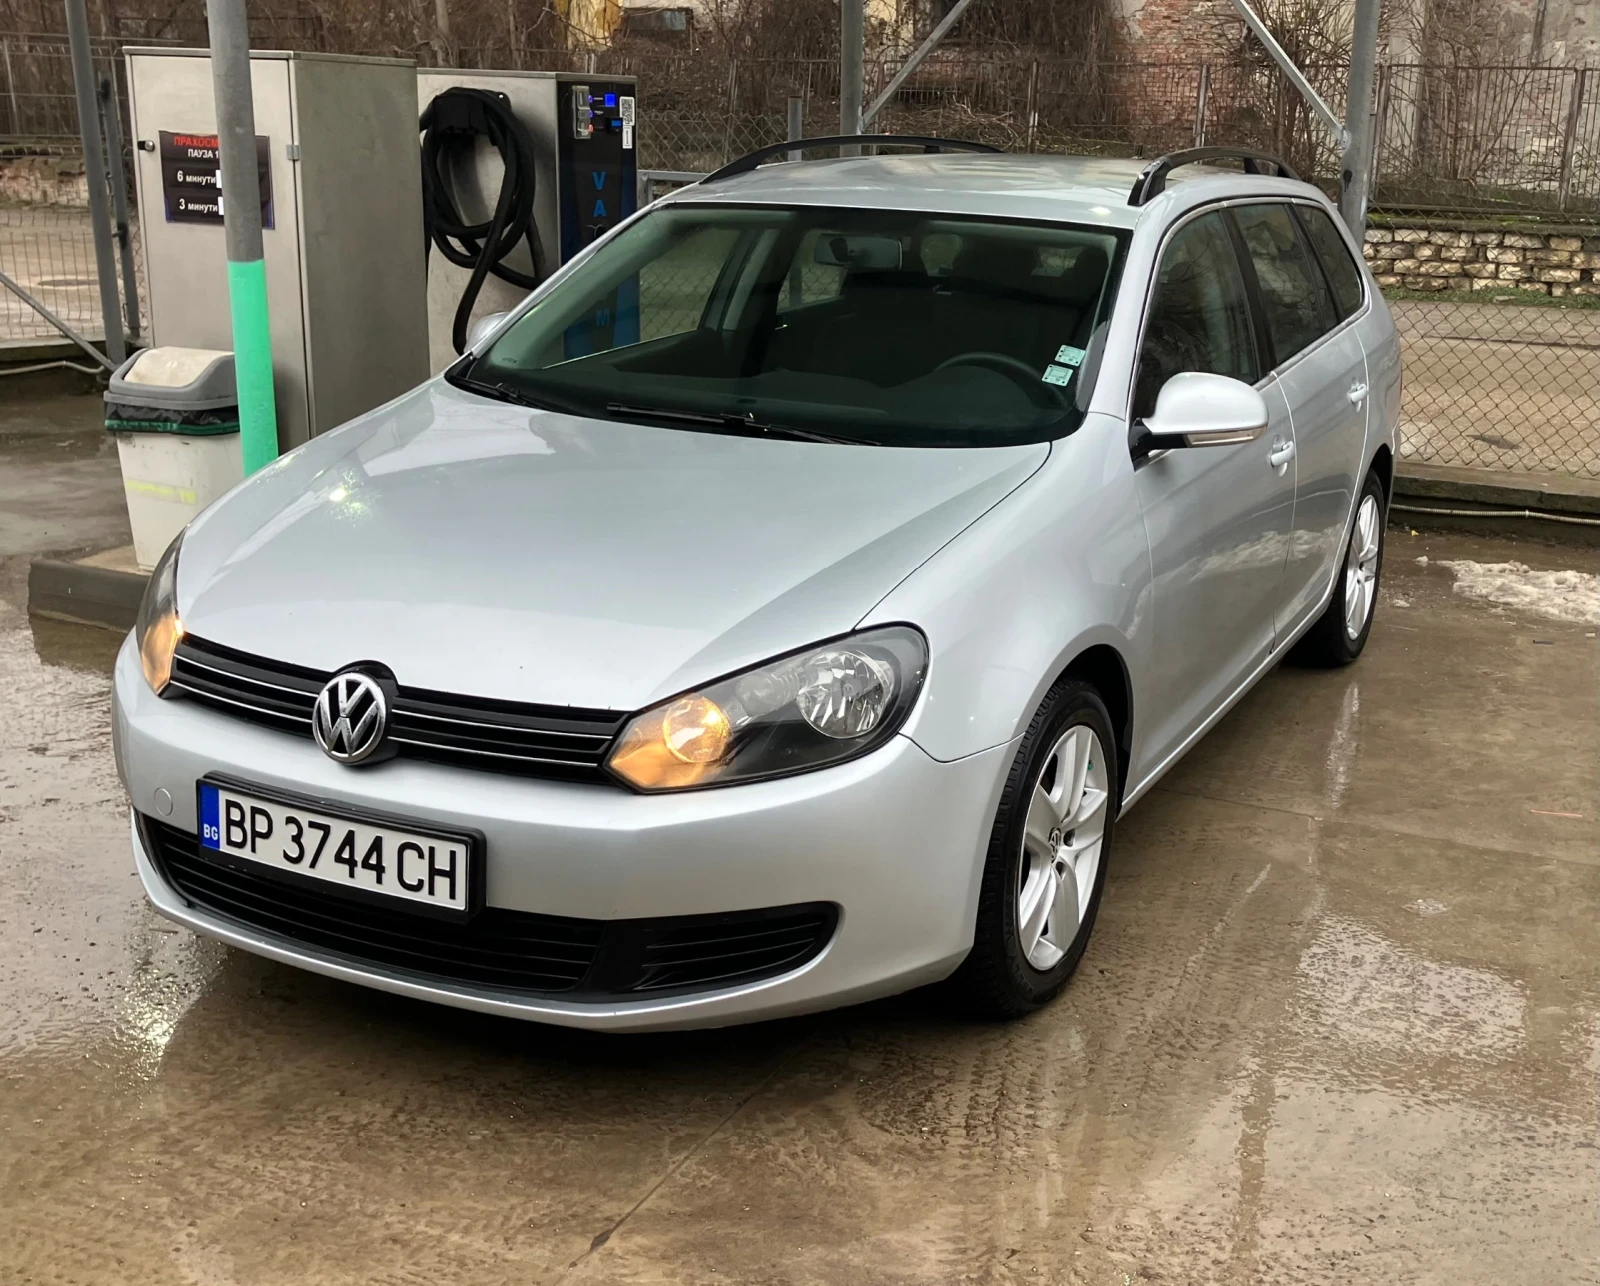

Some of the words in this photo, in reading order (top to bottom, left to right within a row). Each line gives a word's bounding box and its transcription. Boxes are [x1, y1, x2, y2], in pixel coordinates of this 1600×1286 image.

[174, 136, 220, 148] ПРАХОСМ
[188, 149, 213, 158] ПАУЗА
[177, 170, 184, 182] 6
[186, 174, 216, 185] минути
[179, 198, 186, 210] 3
[188, 202, 218, 213] минути
[312, 672, 387, 766] VW
[203, 823, 219, 841] BG
[225, 798, 274, 854] BP
[282, 815, 386, 886] 3744
[396, 841, 457, 900] CH
